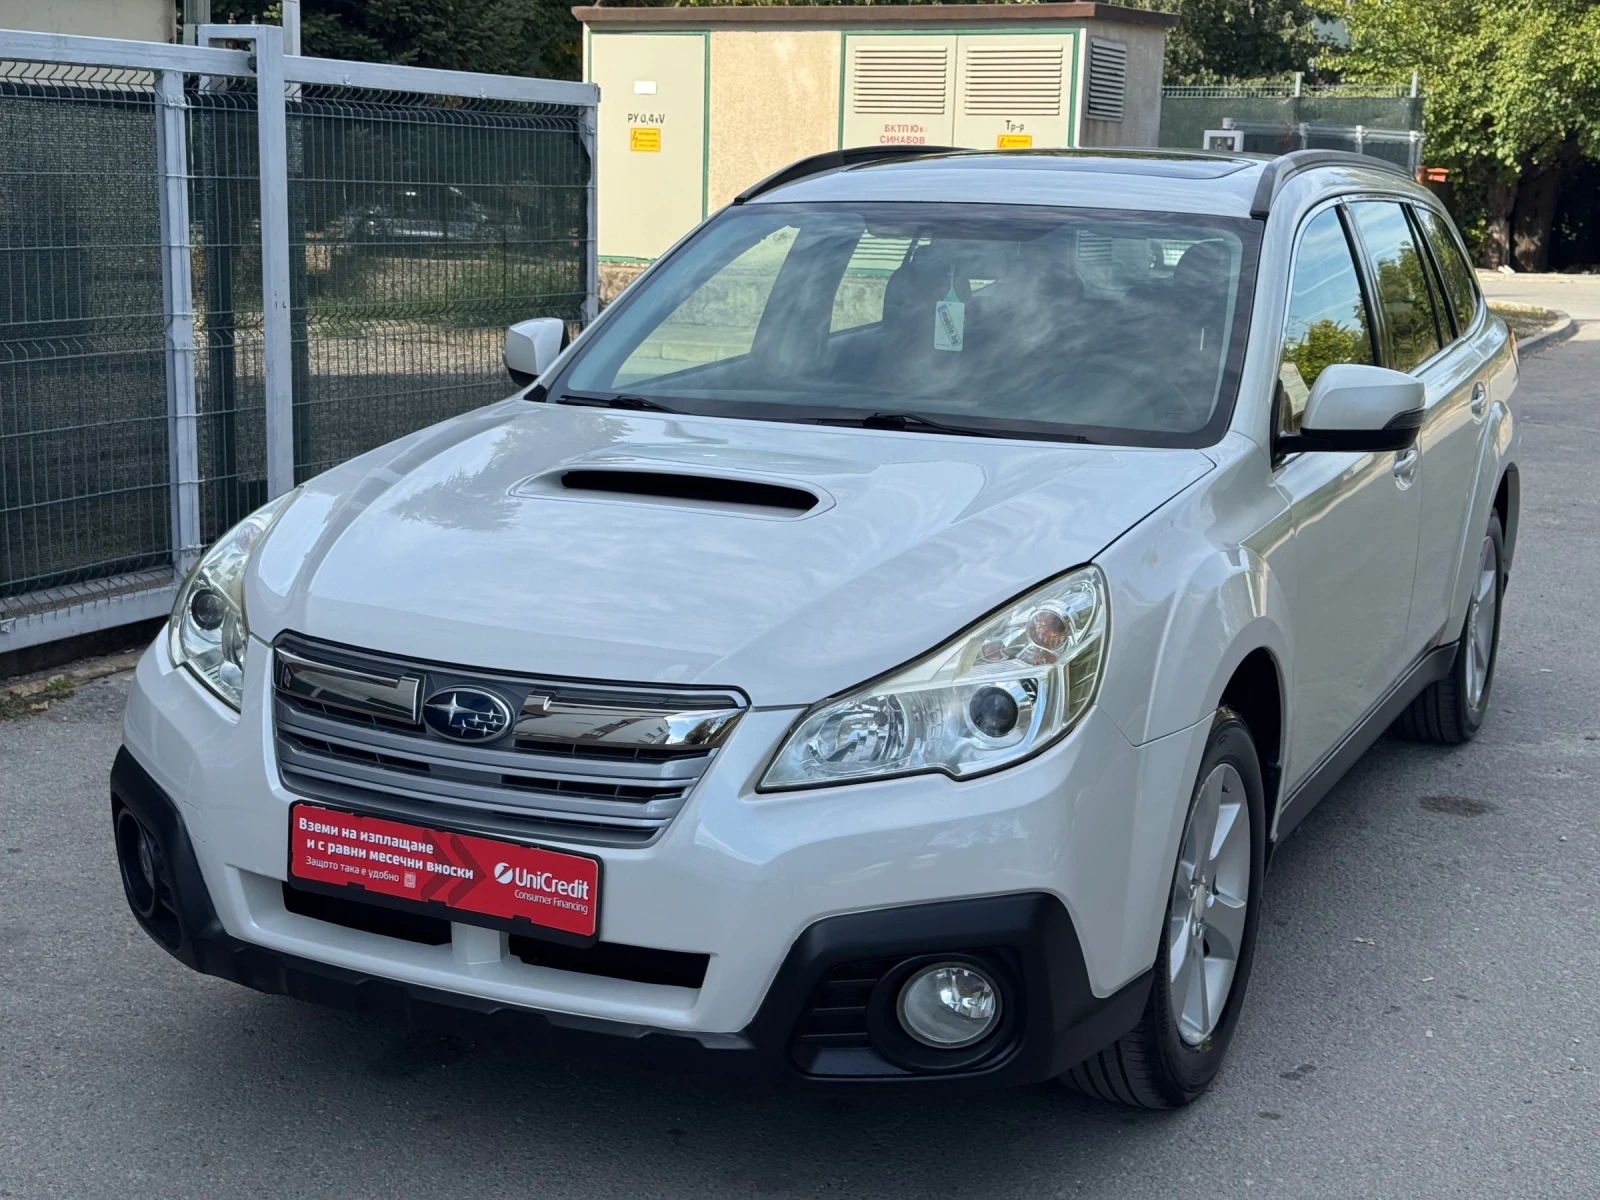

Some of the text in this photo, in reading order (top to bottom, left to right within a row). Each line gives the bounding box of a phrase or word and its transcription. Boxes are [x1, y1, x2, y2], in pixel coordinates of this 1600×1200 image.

[299, 817, 434, 854] Вземи на изплащане
[305, 856, 400, 883] Защото така е удобно
[306, 838, 474, 880] и с равни месечни вноски
[515, 867, 590, 900] UniCredit
[514, 889, 588, 915] Consumer Financing
